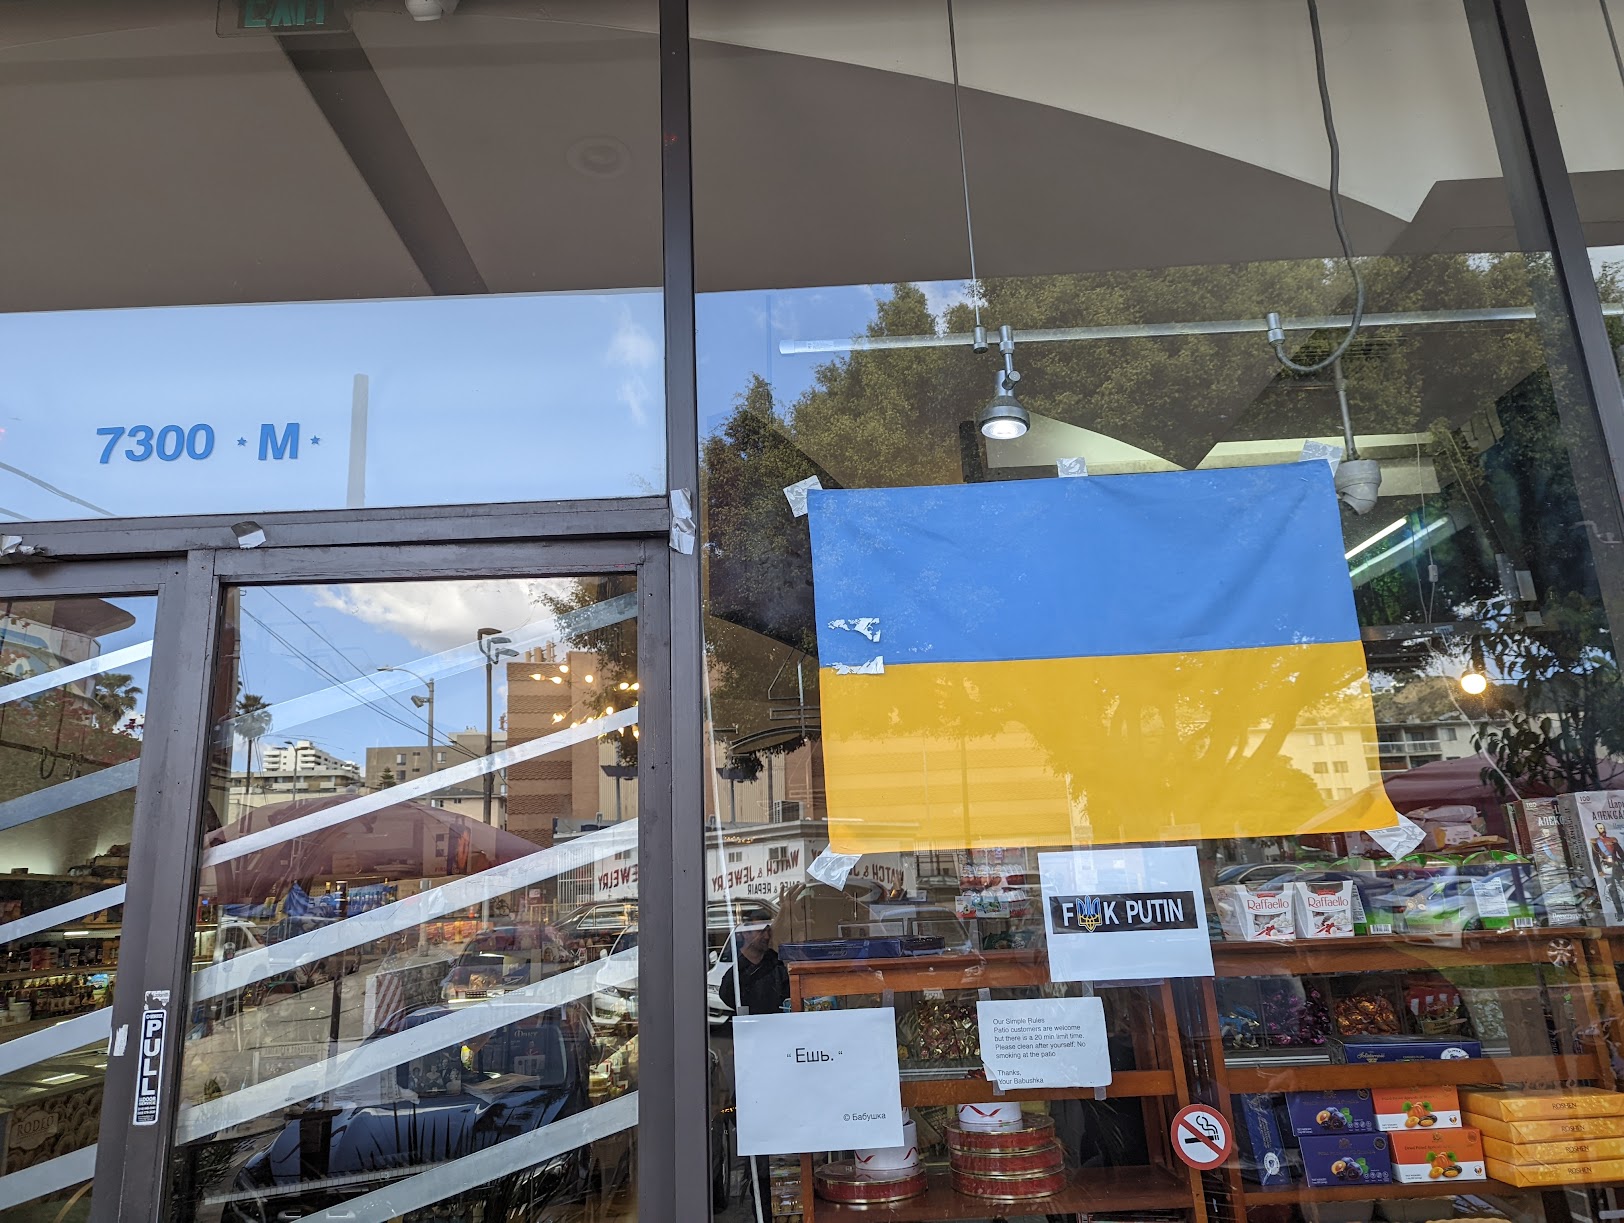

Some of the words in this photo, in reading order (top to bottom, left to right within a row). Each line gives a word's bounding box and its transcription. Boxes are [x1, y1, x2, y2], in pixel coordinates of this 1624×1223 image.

[96, 423, 215, 464] 7300
[258, 422, 300, 460] M
[1247, 898, 1290, 911] Raffaello
[1307, 897, 1349, 909] Raffaello
[1125, 898, 1185, 924] PUTIN
[1005, 1017, 1026, 1025] Simple
[993, 1026, 1010, 1034] Patio
[1076, 1040, 1087, 1048] No
[141, 1019, 162, 1096] PULL
[995, 1051, 1021, 1060] smoking
[1040, 1050, 1056, 1058] patio
[997, 1069, 1022, 1077] Thanks,
[1013, 1076, 1044, 1085] Babushka
[1551, 1102, 1577, 1110] ROSHEN
[852, 1112, 887, 1122] Бабушка
[1561, 1124, 1585, 1132] ROSHEN
[1565, 1145, 1590, 1153] ROSHEN
[1567, 1166, 1593, 1174] ROSHEN
